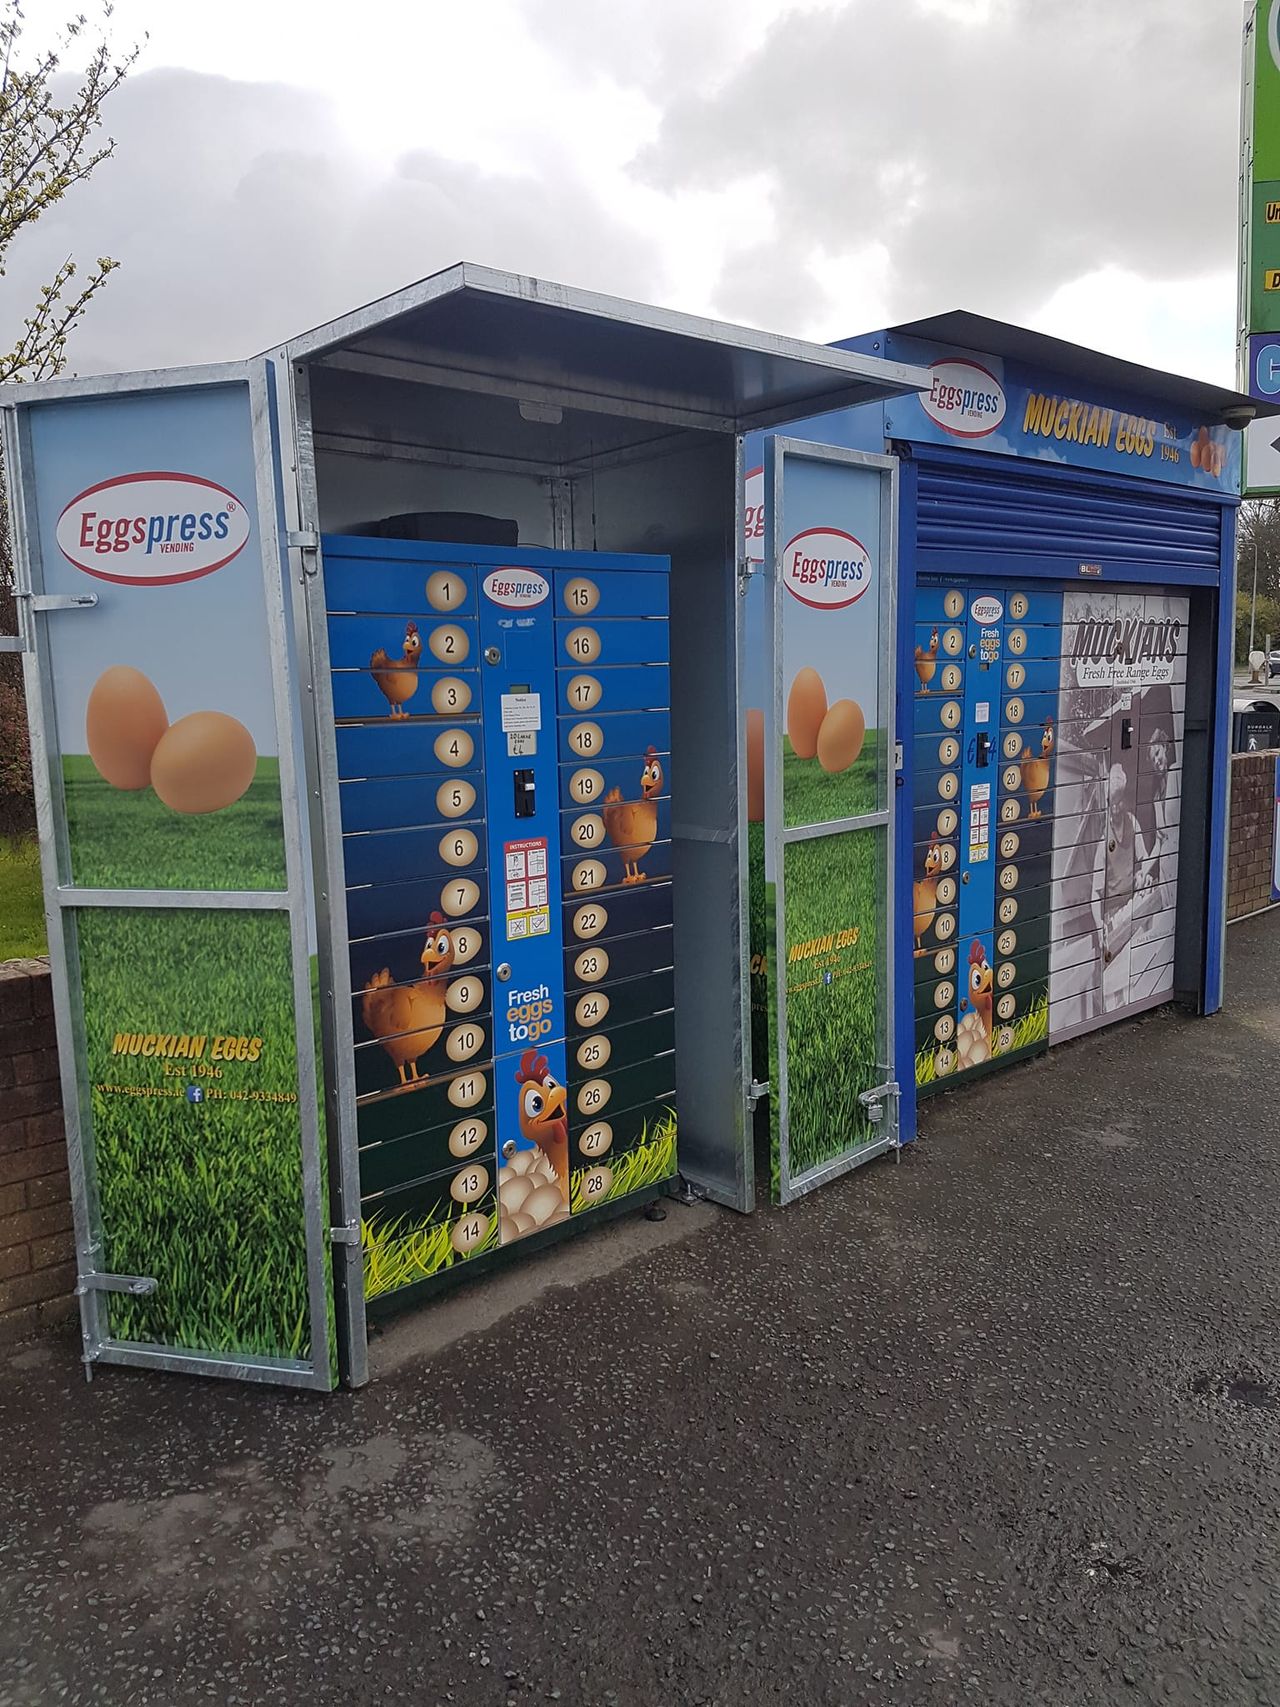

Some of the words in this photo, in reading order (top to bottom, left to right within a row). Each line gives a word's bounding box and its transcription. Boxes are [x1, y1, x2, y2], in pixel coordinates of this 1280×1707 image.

[930, 377, 998, 415] Eggspress
[1023, 393, 1113, 448] MUCKIAN
[1115, 413, 1157, 458] EGGS
[1160, 444, 1180, 464] 1946
[80, 511, 230, 554] Eggspress
[160, 542, 194, 554] VENDING
[792, 551, 864, 587] Eggspress
[442, 583, 450, 600] 1
[492, 578, 543, 598] Eggspress
[572, 589, 588, 606] 15
[952, 598, 956, 610] 1
[974, 604, 1000, 617] Eggspress
[1014, 600, 1022, 613] 15
[980, 628, 1000, 638] Fresh
[446, 636, 454, 654] 2
[574, 638, 590, 654] 16
[950, 636, 956, 648] 2
[980, 638, 1000, 650] eggs
[1012, 636, 1020, 648] 16
[1071, 616, 1180, 667] MUCKIANS
[949, 672, 954, 684] 3
[1011, 671, 1020, 682] 17
[1082, 666, 1105, 680] Fresh
[1107, 666, 1124, 679] Free
[1126, 666, 1150, 681] Range
[1151, 665, 1170, 681] Eggs
[448, 688, 456, 706] 3
[575, 686, 590, 702] 17
[948, 708, 954, 720] 4
[1010, 705, 1018, 717] 18
[450, 740, 460, 756] 4
[576, 732, 592, 748] 18
[1008, 740, 1016, 752] 19
[946, 746, 952, 758] 5
[578, 778, 593, 794] 19
[946, 780, 951, 792] 6
[1006, 773, 1016, 784] 20
[452, 790, 462, 806] 5
[1006, 808, 1014, 818] 21
[946, 816, 950, 828] 7
[578, 824, 594, 840] 20
[454, 840, 464, 856] 6
[510, 840, 542, 850] INSTRUCTIONS
[1004, 840, 1013, 852] 22
[944, 850, 949, 863] 8
[580, 869, 594, 886] 21
[1004, 872, 1012, 884] 23
[457, 888, 465, 905] 7
[944, 886, 948, 898] 9
[1003, 905, 1012, 917] 24
[581, 914, 596, 930] 22
[941, 920, 950, 932] 10
[458, 937, 468, 954] 8
[788, 934, 834, 964] MUCKIAN
[835, 926, 860, 950] EGGS
[582, 958, 598, 974] 23
[940, 954, 948, 966] 11
[460, 986, 470, 1002] 9
[508, 984, 549, 1006] Fresh
[940, 988, 949, 1000] 12
[506, 998, 553, 1025] eggs
[583, 1002, 598, 1018] 24
[940, 1022, 949, 1034] 13
[112, 1032, 207, 1060] MUCKIAN
[210, 1035, 264, 1062] EGGS
[458, 1032, 474, 1050] 10
[584, 1045, 600, 1062] 25
[940, 1055, 948, 1068] 14
[164, 1062, 187, 1078] Est
[191, 1064, 223, 1080] 1946
[459, 1080, 474, 1098] 11
[585, 1088, 600, 1106] 26
[460, 1127, 477, 1146] 12
[586, 1132, 602, 1150] 27
[461, 1174, 478, 1194] 13
[588, 1175, 603, 1194] 28
[462, 1221, 480, 1241] 14
